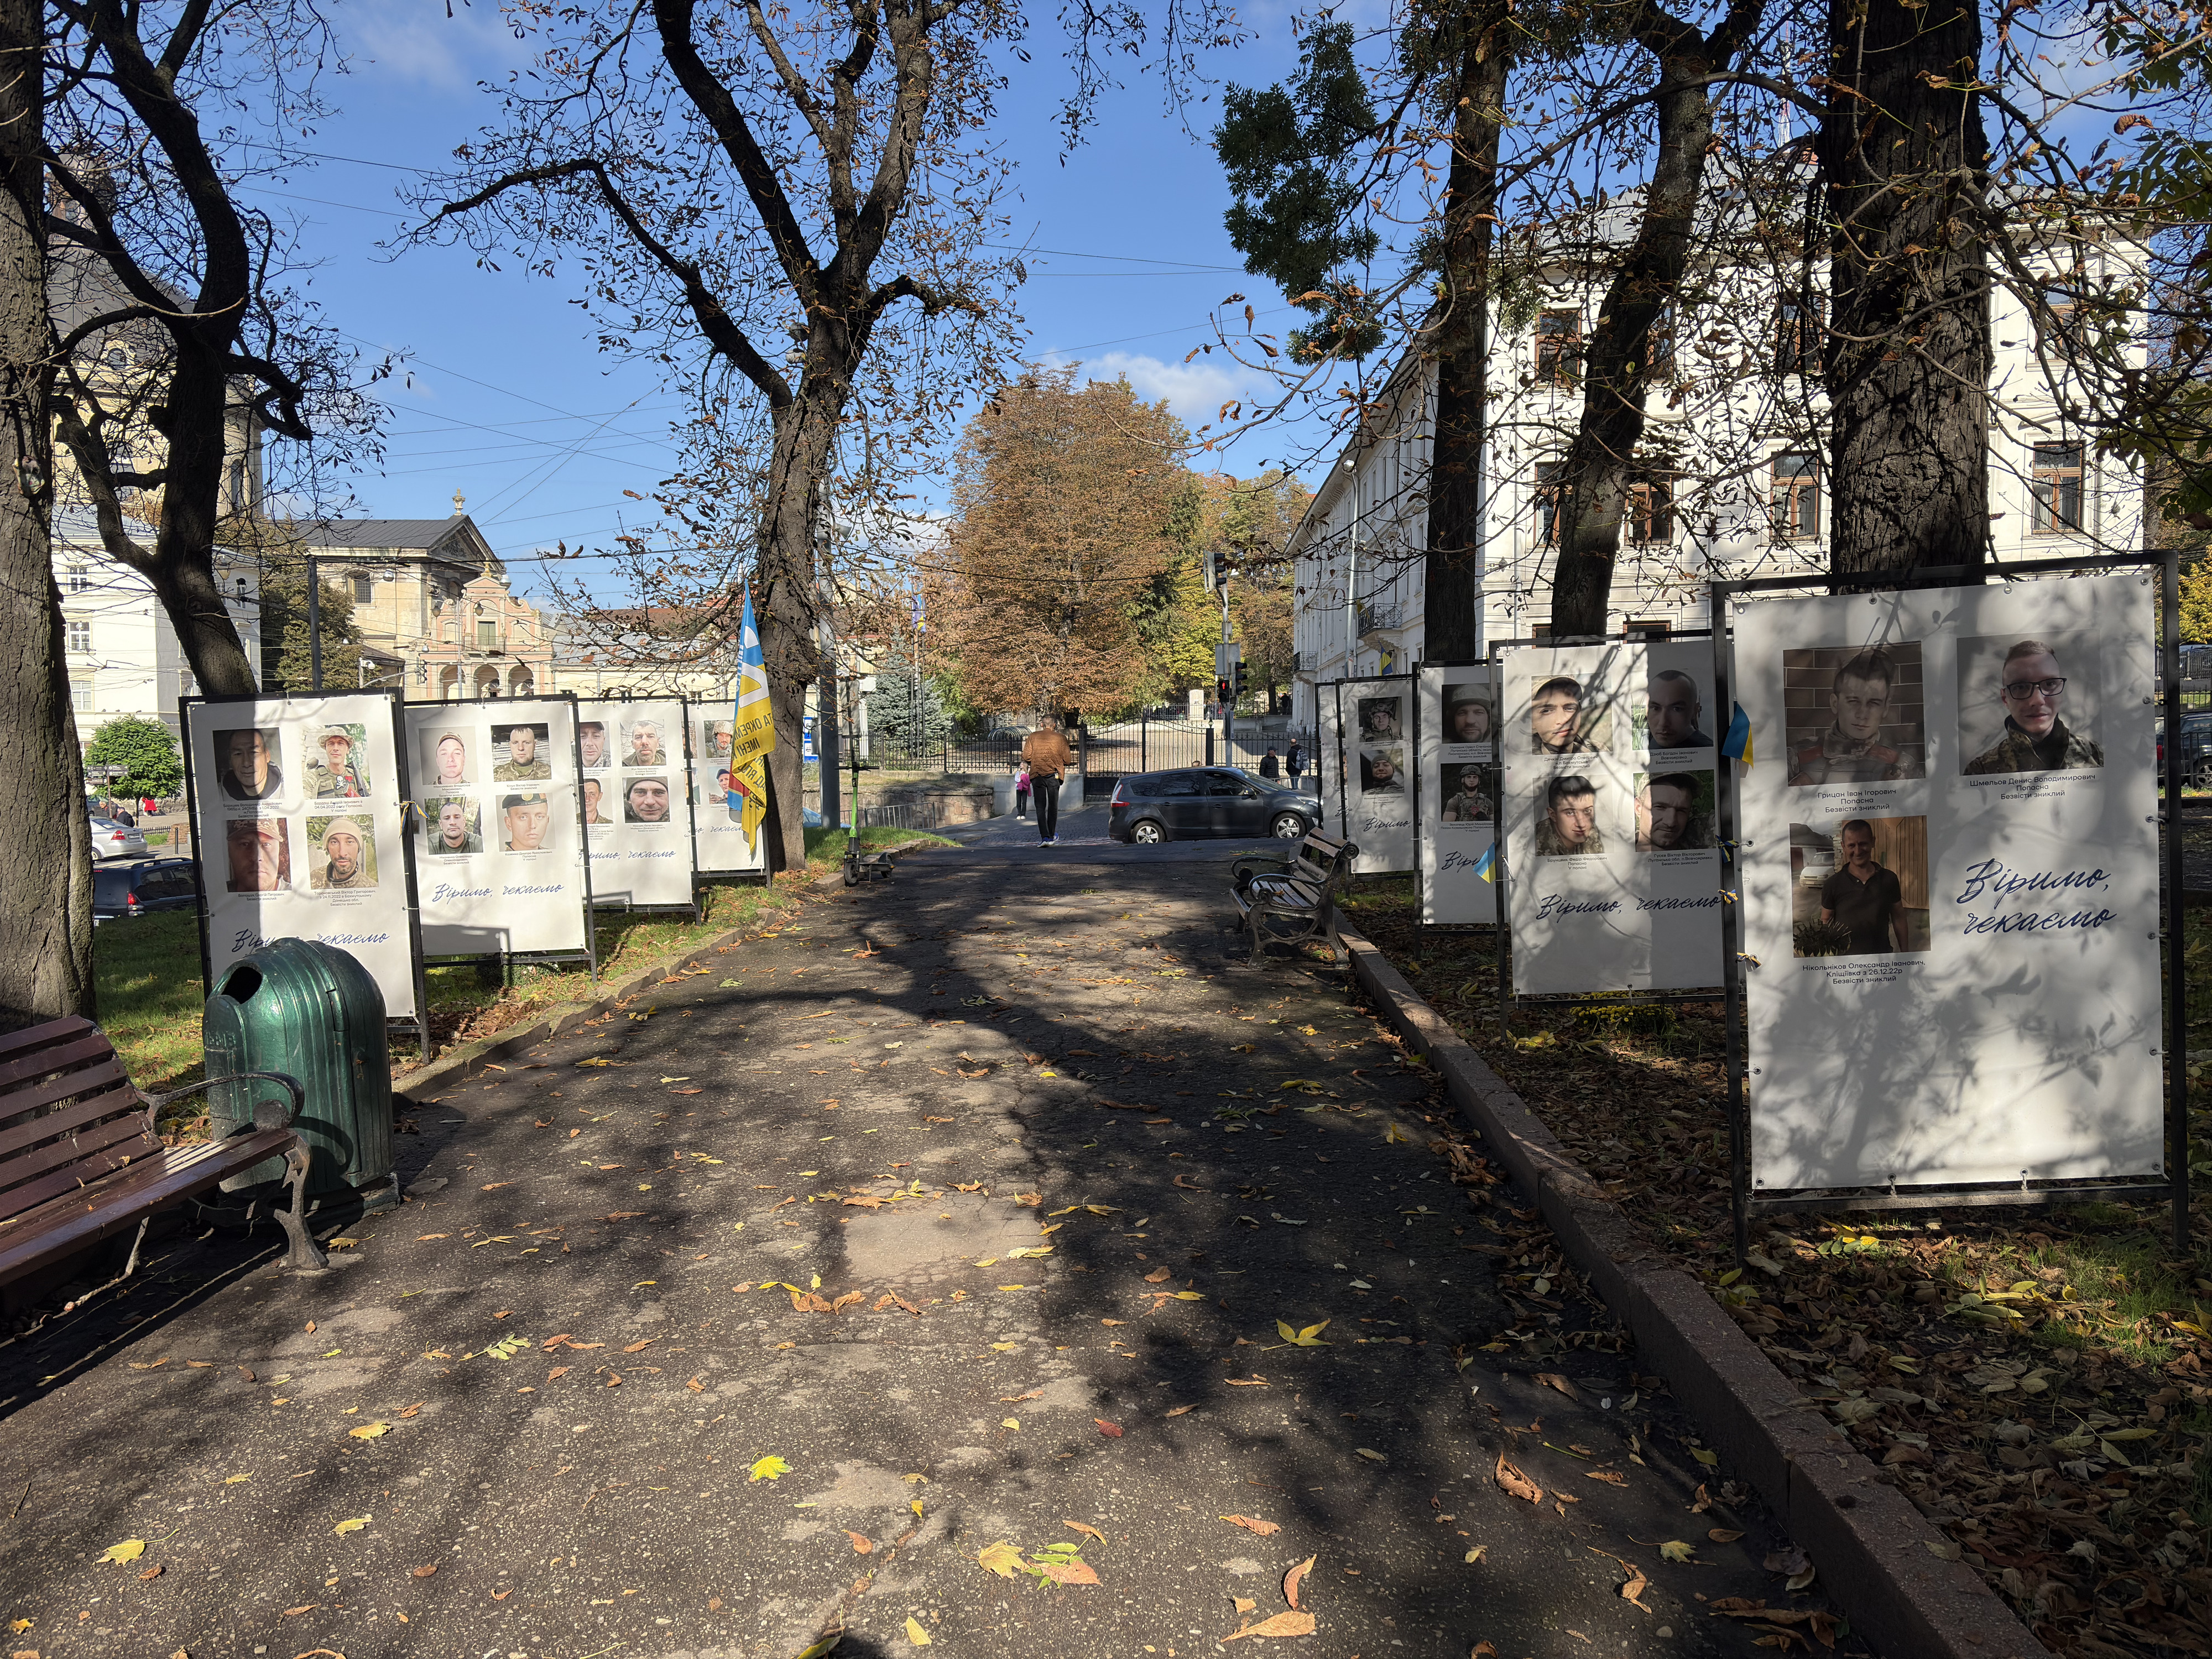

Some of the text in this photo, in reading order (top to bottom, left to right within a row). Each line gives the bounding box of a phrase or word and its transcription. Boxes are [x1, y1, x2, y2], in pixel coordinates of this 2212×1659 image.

[2033, 774, 2096, 783] Володимирович
[2000, 792, 2033, 800] Безвісти
[1363, 817, 1411, 833] Віримо,
[1956, 858, 2112, 910] Віримо,
[432, 883, 564, 905] Віримо, чекаємо
[1536, 893, 1721, 923] Віримо, чекаємо
[1963, 909, 2118, 935] чекаємо
[1848, 961, 1890, 969] Олександр
[1826, 969, 1862, 978] Кліщіївка
[1868, 968, 1903, 976] 26.12.22р
[1865, 974, 1897, 983] зниклий
